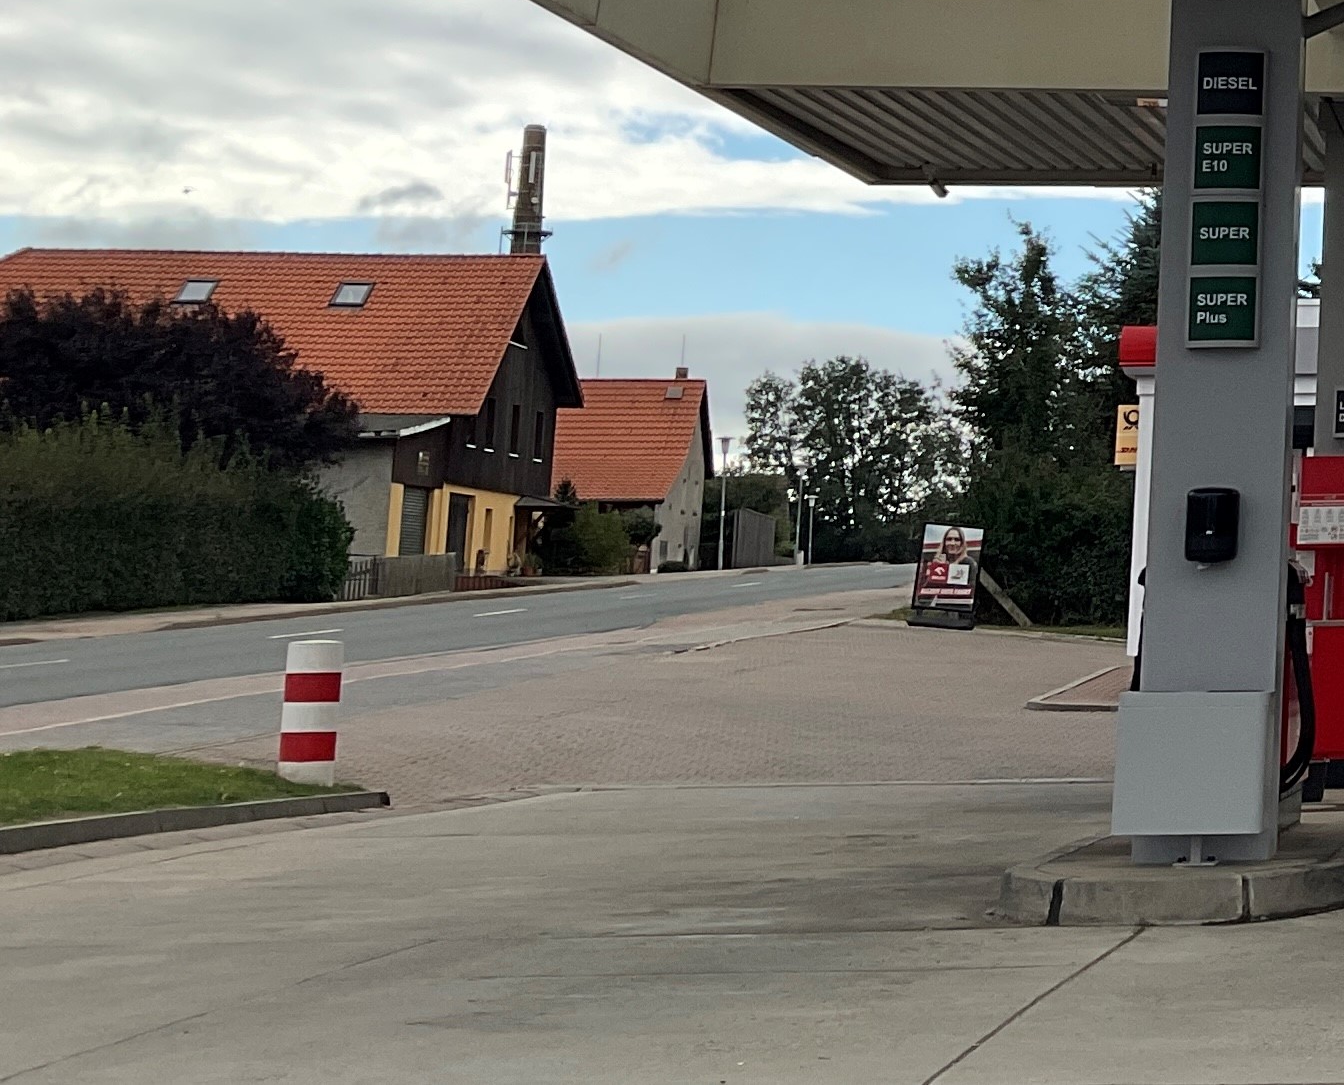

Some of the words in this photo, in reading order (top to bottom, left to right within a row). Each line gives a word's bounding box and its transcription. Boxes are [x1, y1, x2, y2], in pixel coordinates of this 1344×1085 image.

[1202, 76, 1258, 90] DIESEL
[1202, 142, 1253, 155] SUPER
[1202, 159, 1228, 172] E10
[1199, 226, 1250, 240] SUPER
[1196, 293, 1248, 306] SUPER
[1196, 311, 1227, 324] Plus
